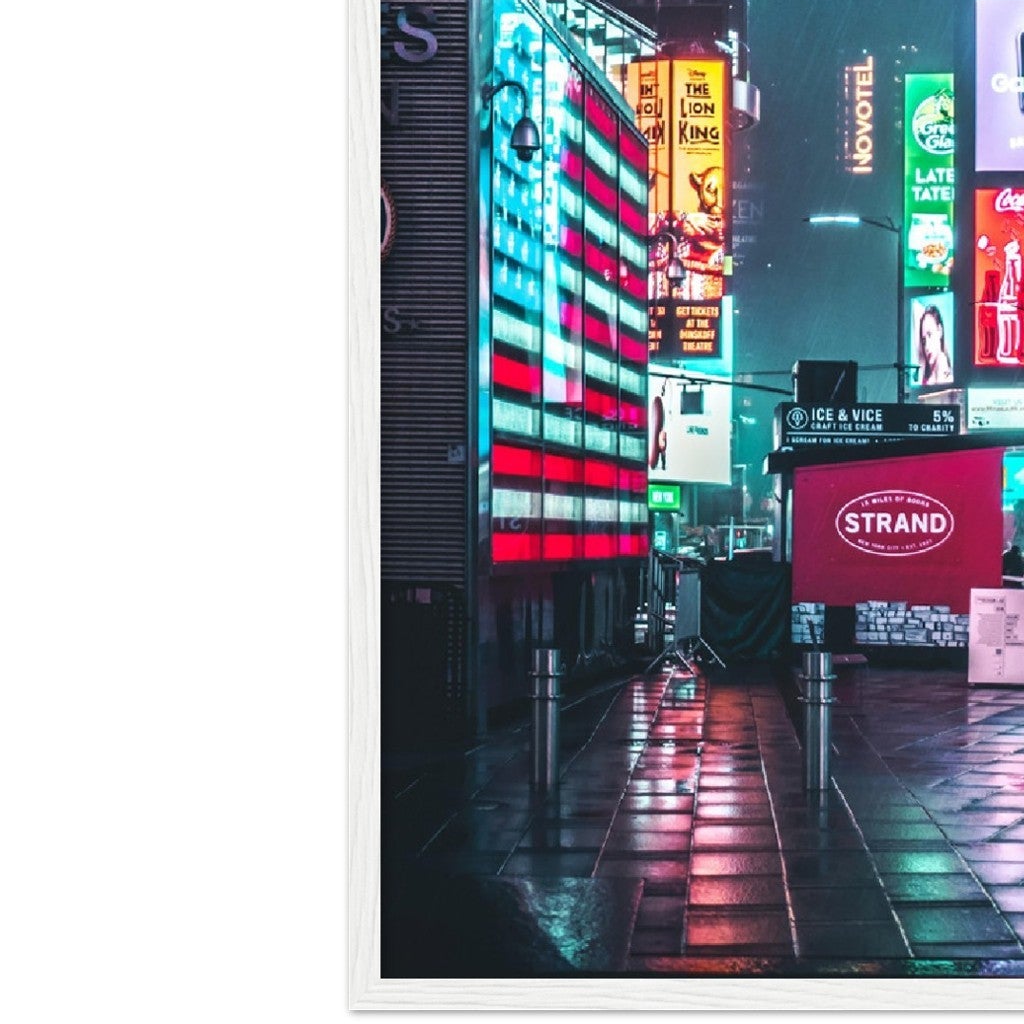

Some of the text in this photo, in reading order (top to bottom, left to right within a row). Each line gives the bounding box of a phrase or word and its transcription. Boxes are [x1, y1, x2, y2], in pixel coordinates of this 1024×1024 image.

[685, 83, 709, 95] THE
[680, 98, 715, 118] LION
[852, 55, 873, 173] NOVOTEL
[678, 120, 720, 144] KING
[915, 167, 955, 184] LATE
[912, 186, 955, 202] TATE
[811, 407, 882, 422] ICE & VICE
[932, 409, 955, 423] 5%
[810, 423, 884, 432] CRAFT ICE CREAM
[908, 423, 955, 432] TO CHARITY
[845, 512, 947, 533] STRAND
